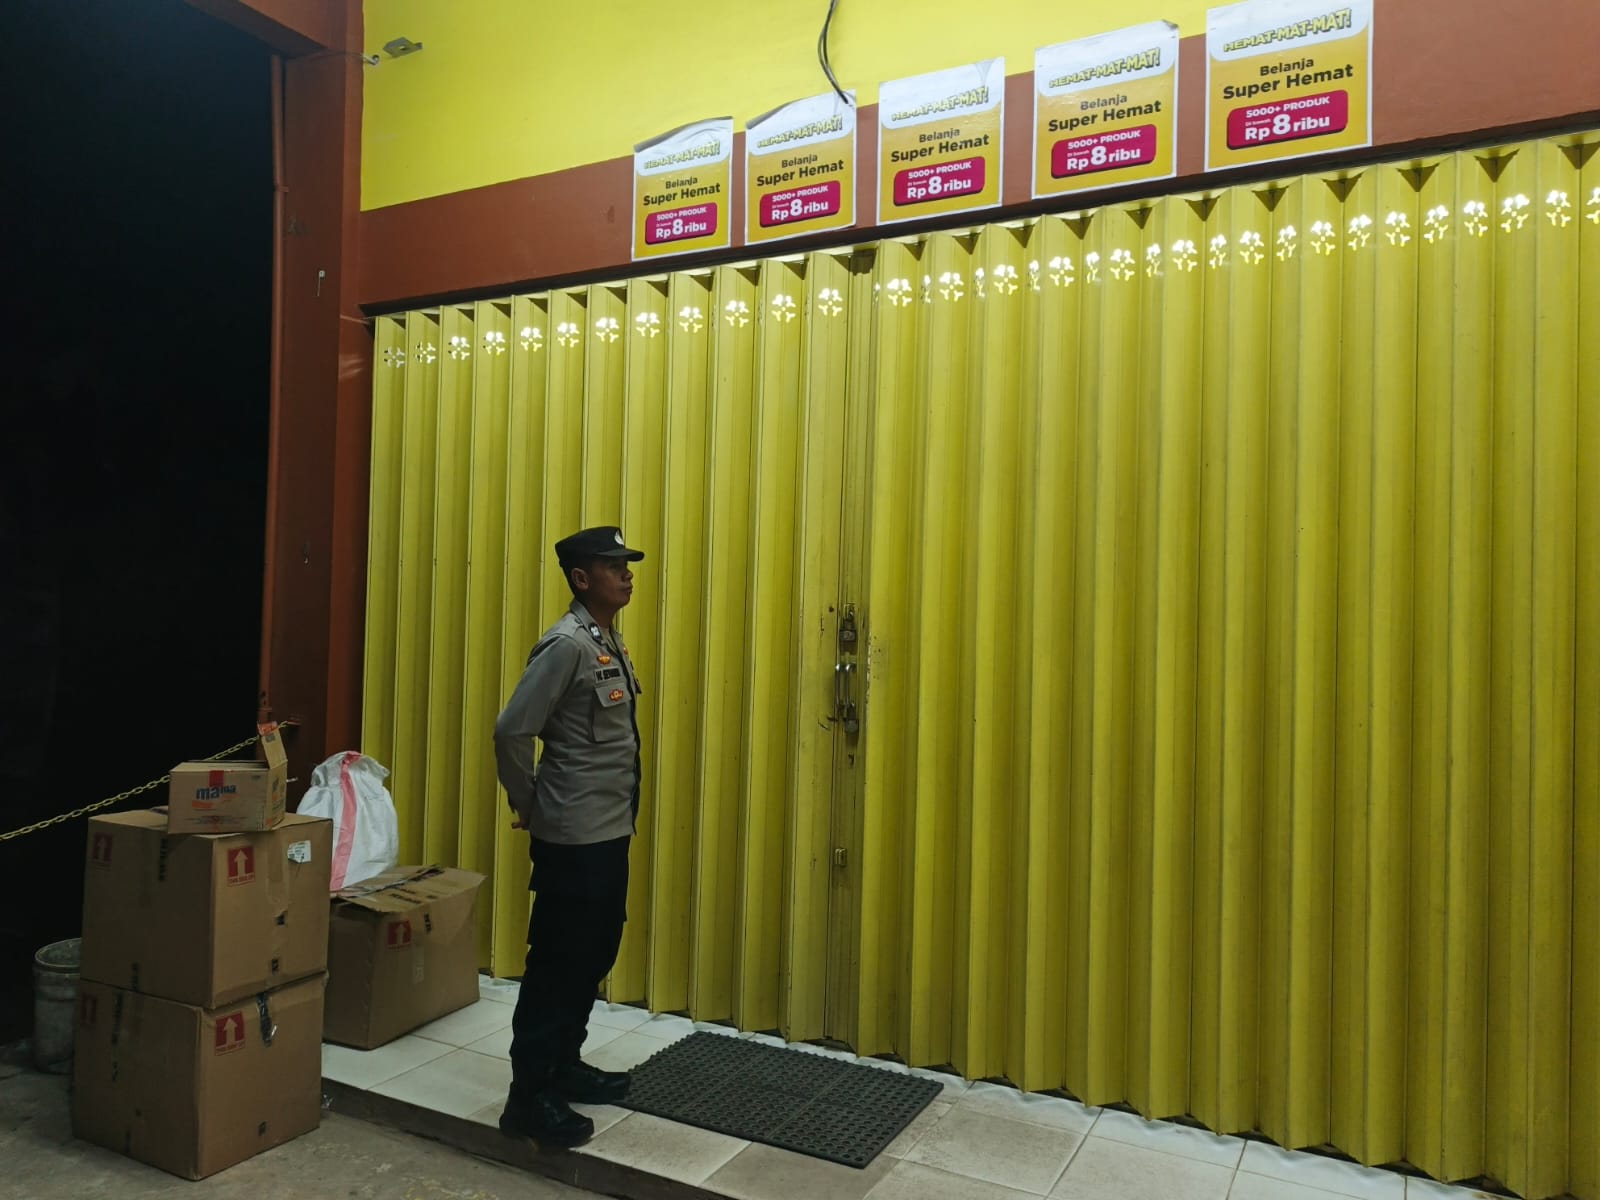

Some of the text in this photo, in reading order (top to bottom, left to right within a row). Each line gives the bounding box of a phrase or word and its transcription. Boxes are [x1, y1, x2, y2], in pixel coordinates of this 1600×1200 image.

[1223, 7, 1352, 52] HEMAT-MAT-MAT!
[1049, 47, 1161, 88] HEMAT-MAT-MAT!
[1260, 58, 1314, 76] Belanja
[1223, 64, 1354, 99] Super Hemat
[1080, 94, 1127, 110] Belanja
[1246, 96, 1330, 118] 5000+ PRODUK
[1048, 100, 1161, 132] Super Hemat
[1293, 116, 1330, 131] ribu
[919, 128, 960, 143] Belanja
[1068, 130, 1141, 149] 5000+ PRODUK
[891, 134, 989, 162] Super Hemat
[1108, 148, 1140, 163] ribu
[781, 153, 818, 168] Belanja
[757, 160, 844, 186] Super Hemat
[908, 161, 972, 179] 5000+ PRODUK
[665, 176, 698, 189] Belanja
[943, 179, 971, 192] ribu
[643, 182, 720, 206] Super Hemat
[772, 186, 828, 202] 5000+ PRODUK
[656, 206, 706, 221] 5000+ PRODUK
[804, 200, 828, 213] ribu
[684, 221, 707, 232] ribu
